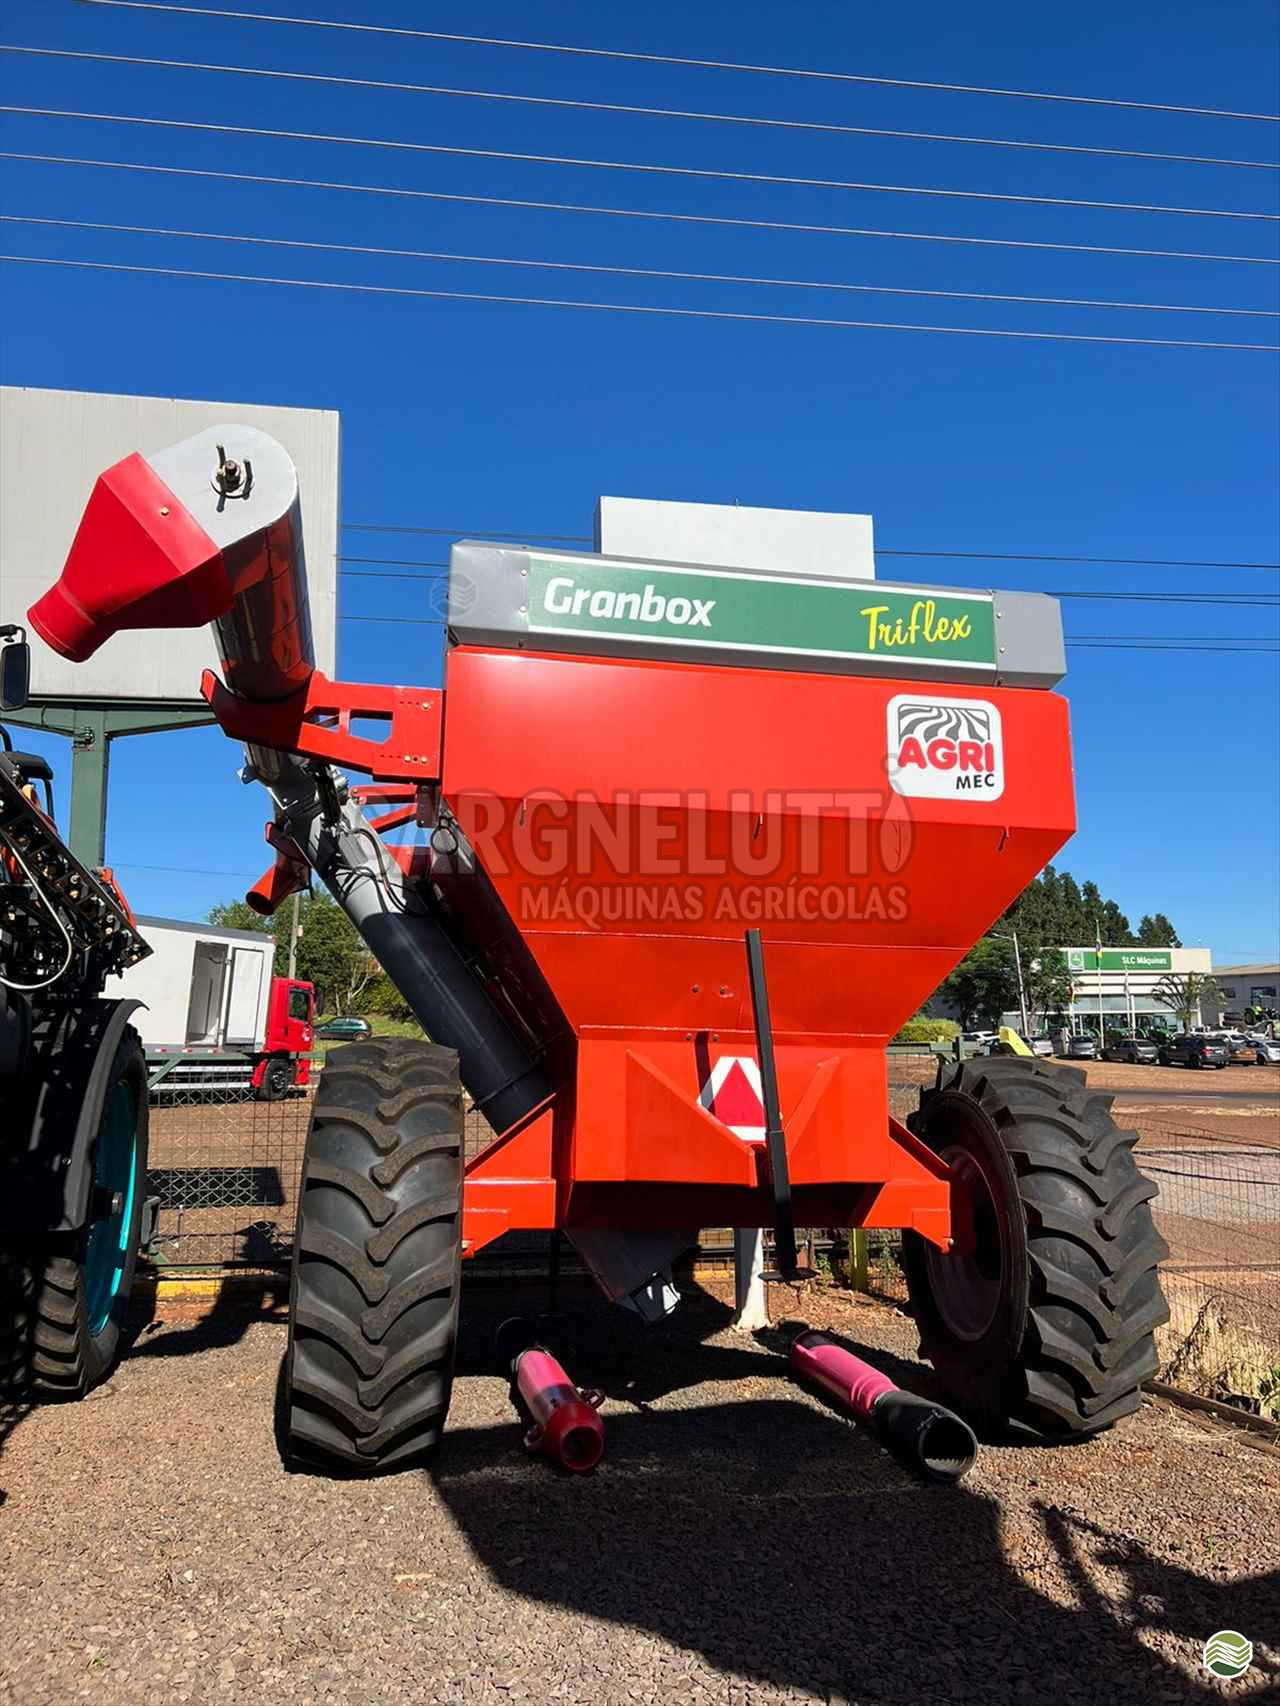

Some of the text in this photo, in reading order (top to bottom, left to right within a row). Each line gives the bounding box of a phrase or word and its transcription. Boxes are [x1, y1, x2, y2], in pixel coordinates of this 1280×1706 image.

[543, 576, 717, 628] Granbox
[860, 599, 972, 651] Triflex
[897, 735, 996, 773] AGRI
[955, 773, 996, 791] MEC
[1121, 955, 1136, 965] SLC
